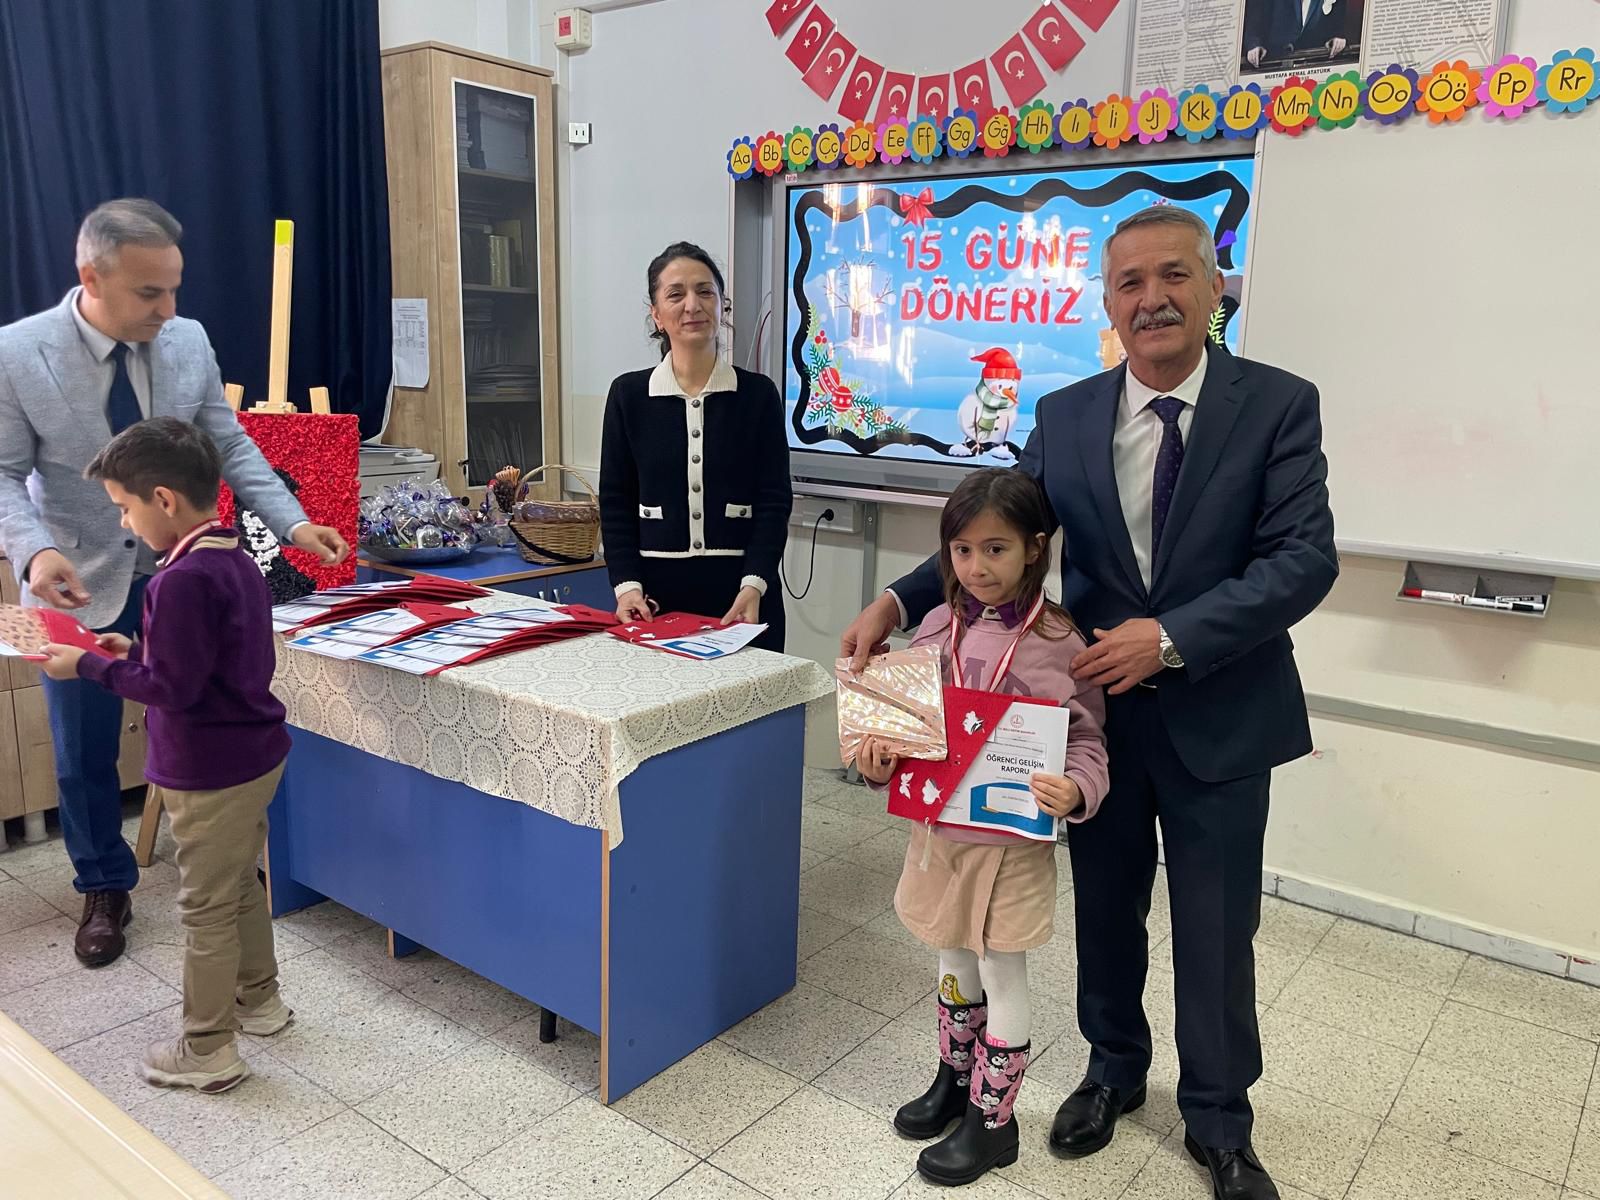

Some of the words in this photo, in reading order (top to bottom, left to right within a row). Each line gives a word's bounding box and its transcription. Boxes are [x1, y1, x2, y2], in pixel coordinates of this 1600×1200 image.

[1264, 72, 1288, 80] MUSTAFA
[733, 151, 751, 167] Aa
[763, 145, 779, 161] Bb
[791, 138, 809, 156] Cc
[819, 137, 839, 159] Çç
[850, 134, 870, 152] Dd
[887, 129, 905, 147] Ee
[917, 127, 932, 153] Ff
[949, 122, 970, 148] Gg
[988, 116, 1009, 146] Ğğ
[1025, 115, 1049, 135] Hh
[1109, 104, 1118, 129] İi
[1145, 102, 1159, 130] Jj
[1187, 100, 1210, 122] Kk
[1233, 98, 1251, 119] Ll
[1277, 94, 1310, 116] Mm
[1323, 87, 1353, 110] Nn
[1372, 81, 1408, 103] Oo
[1429, 73, 1467, 102] Öö
[1497, 72, 1527, 103] Pp
[1559, 67, 1587, 91] Rr
[901, 232, 943, 271] 15
[965, 223, 1092, 271] GÜNE
[901, 275, 1083, 325] DÖNERİZ
[1001, 765, 1030, 775] RAPORU
